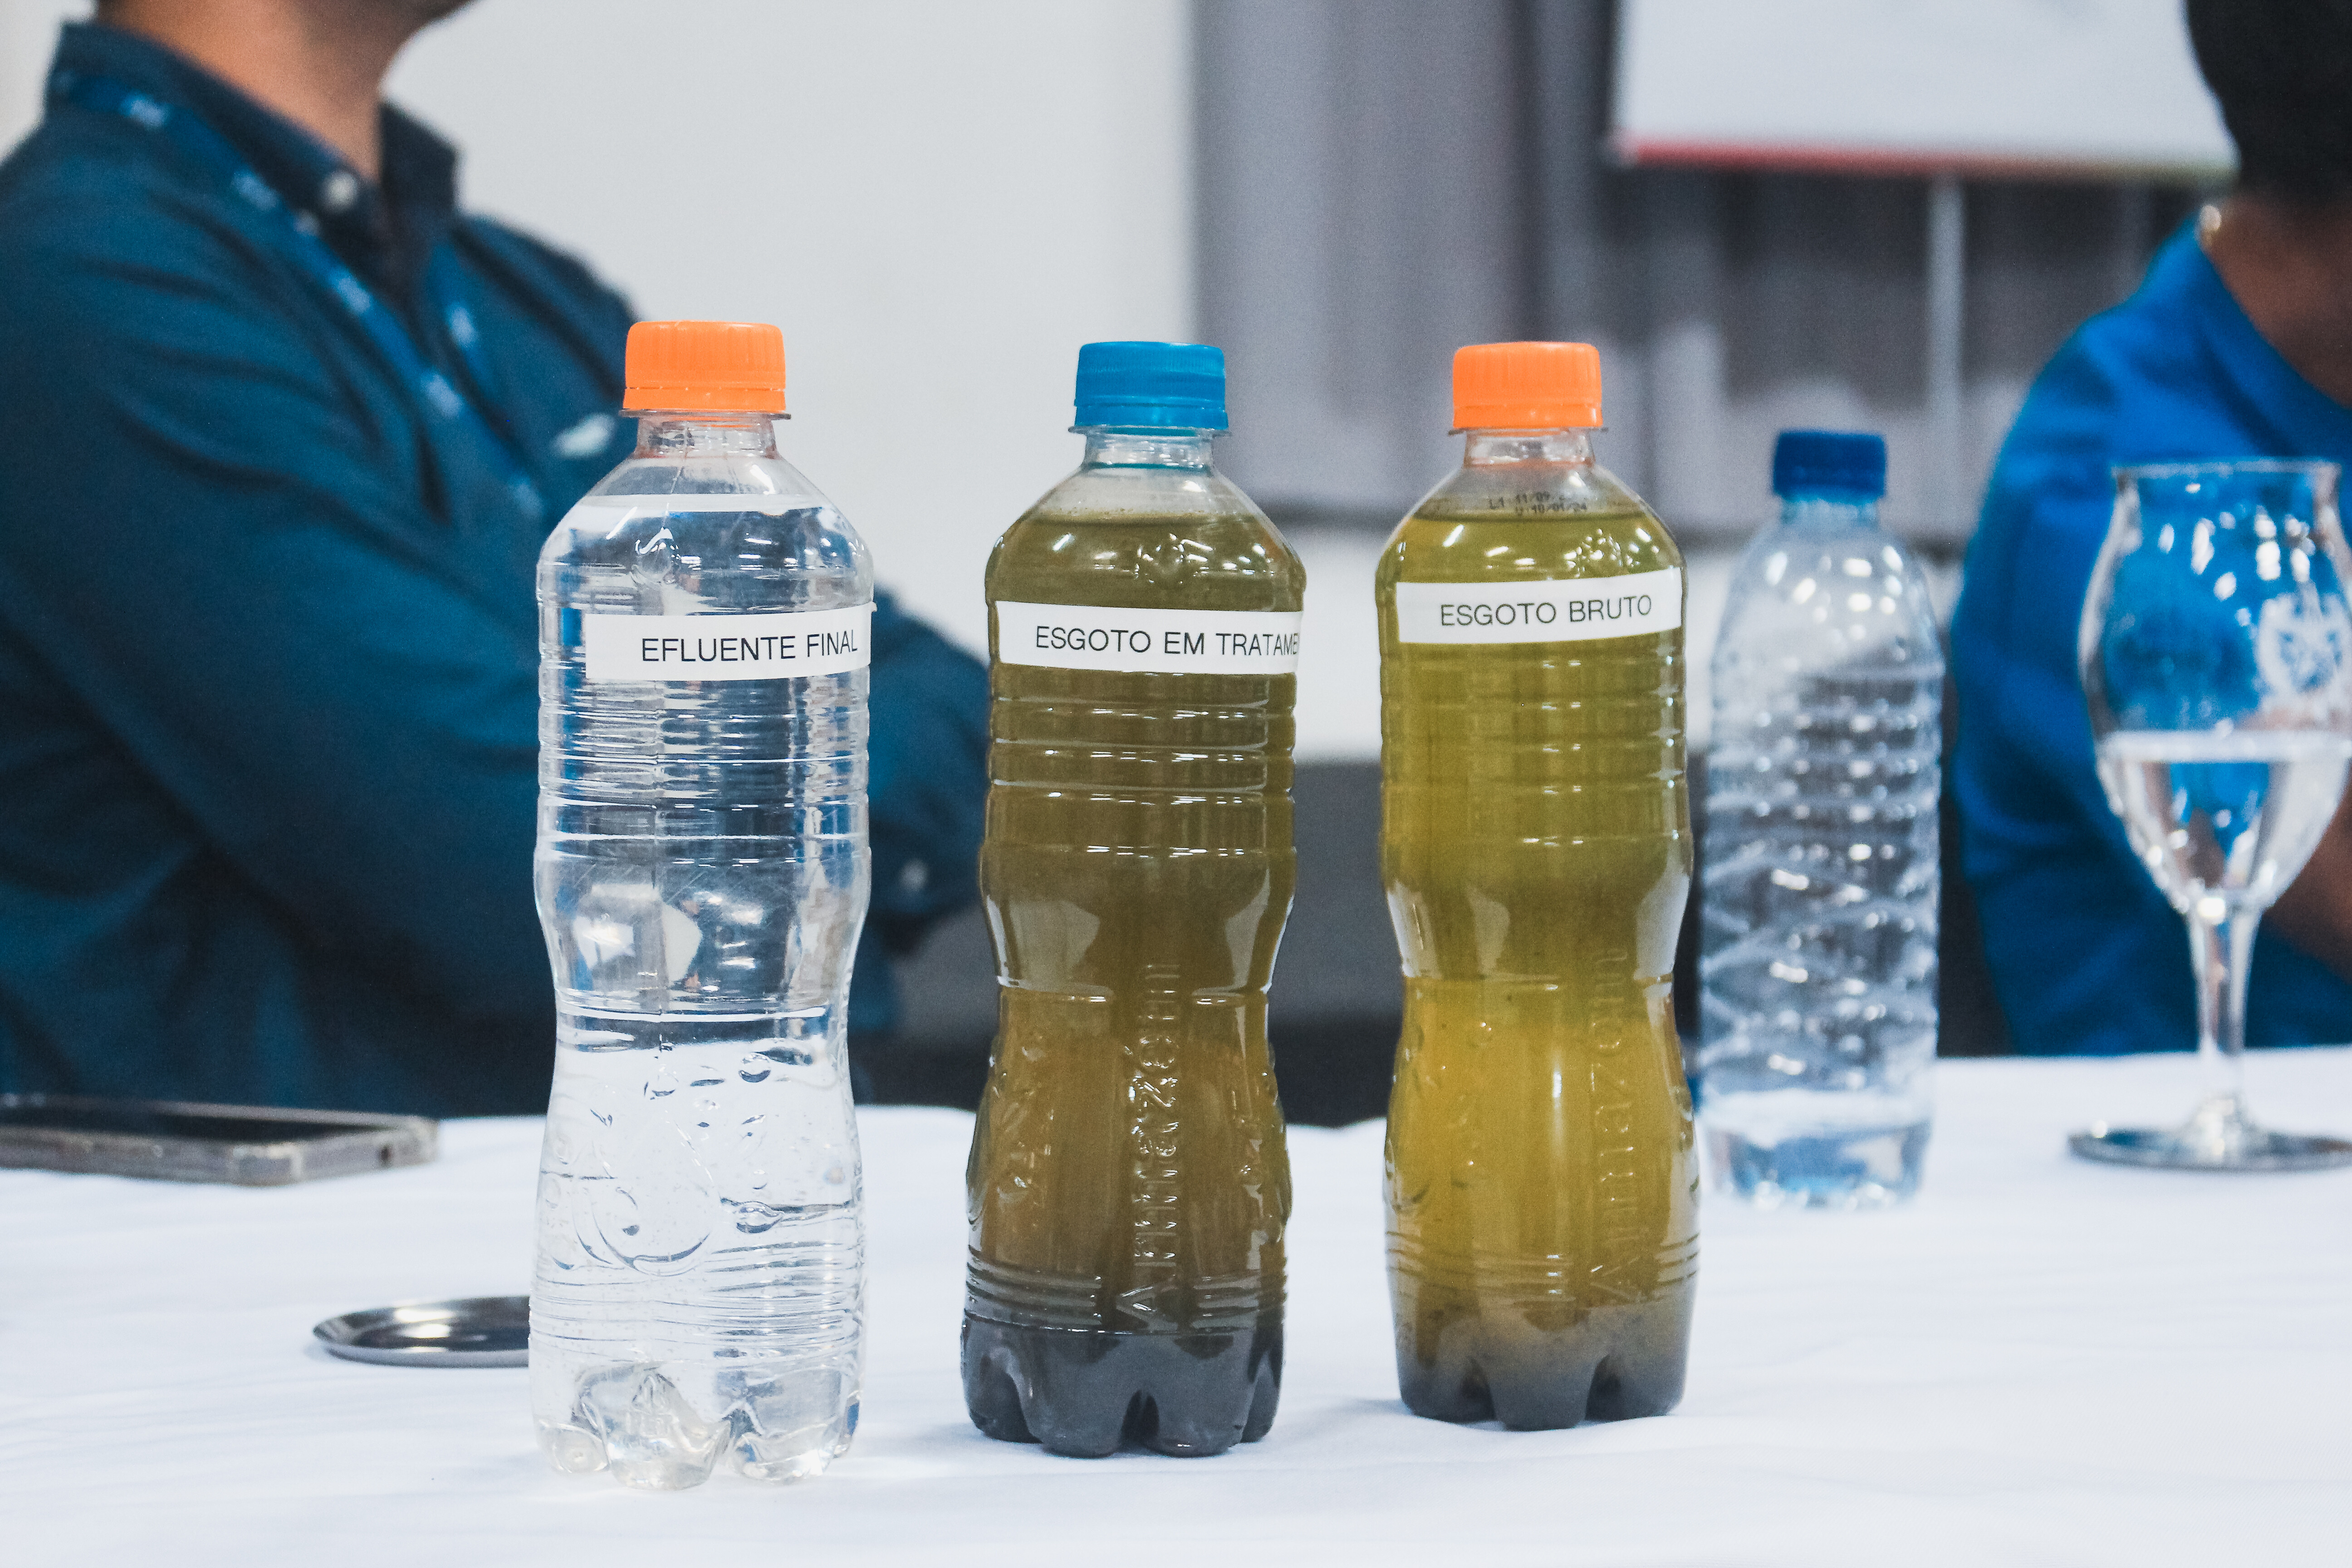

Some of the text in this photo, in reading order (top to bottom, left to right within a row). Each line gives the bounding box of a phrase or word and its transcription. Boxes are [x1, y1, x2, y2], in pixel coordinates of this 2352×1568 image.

[1441, 595, 1652, 626] ESGOTO BRUTO
[642, 629, 858, 662] EFLUENTE FINAL
[1036, 626, 1299, 656] ESGOTO EM TRATAME
